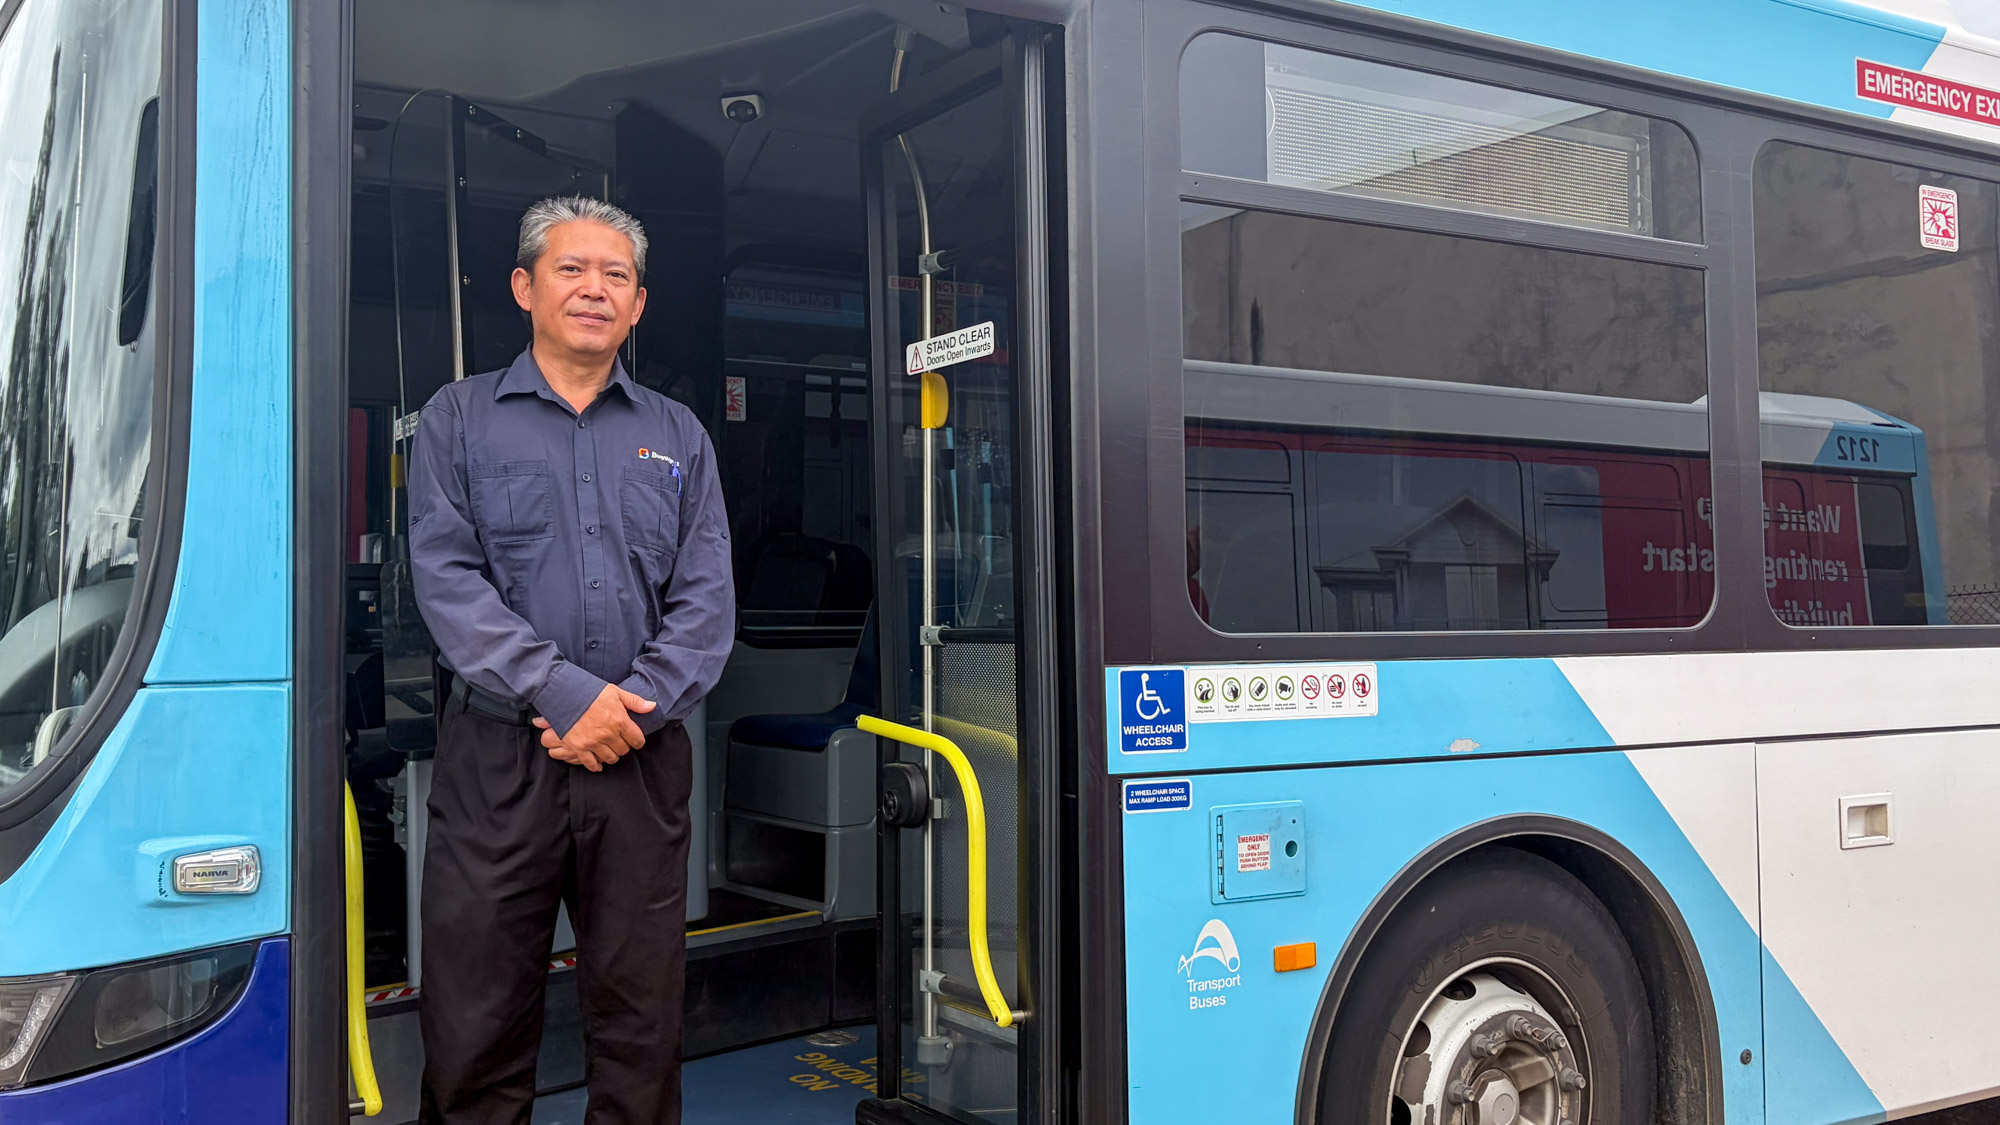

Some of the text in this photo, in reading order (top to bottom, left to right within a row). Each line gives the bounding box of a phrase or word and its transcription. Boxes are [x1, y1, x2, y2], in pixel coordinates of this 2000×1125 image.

[1864, 68, 1972, 113] EMERGENCY
[1927, 189, 1954, 200] EMERGENCY
[1925, 236, 1954, 248] BREAK GLASS
[890, 276, 955, 294] EMERNCY
[926, 326, 991, 354] STAND CLEAR
[926, 341, 991, 366] Doors Open Inwards
[1123, 723, 1184, 735] WHEELCHAIR
[1135, 736, 1173, 747] ACCESS
[1135, 788, 1168, 796] WHEELCHAIR
[1238, 835, 1269, 843] EMERGENCY
[1247, 843, 1260, 851] ONLY
[193, 870, 229, 878] NARVA
[1186, 973, 1241, 992] Transport
[1189, 995, 1227, 1010] Buses
[789, 1073, 840, 1091] NO
